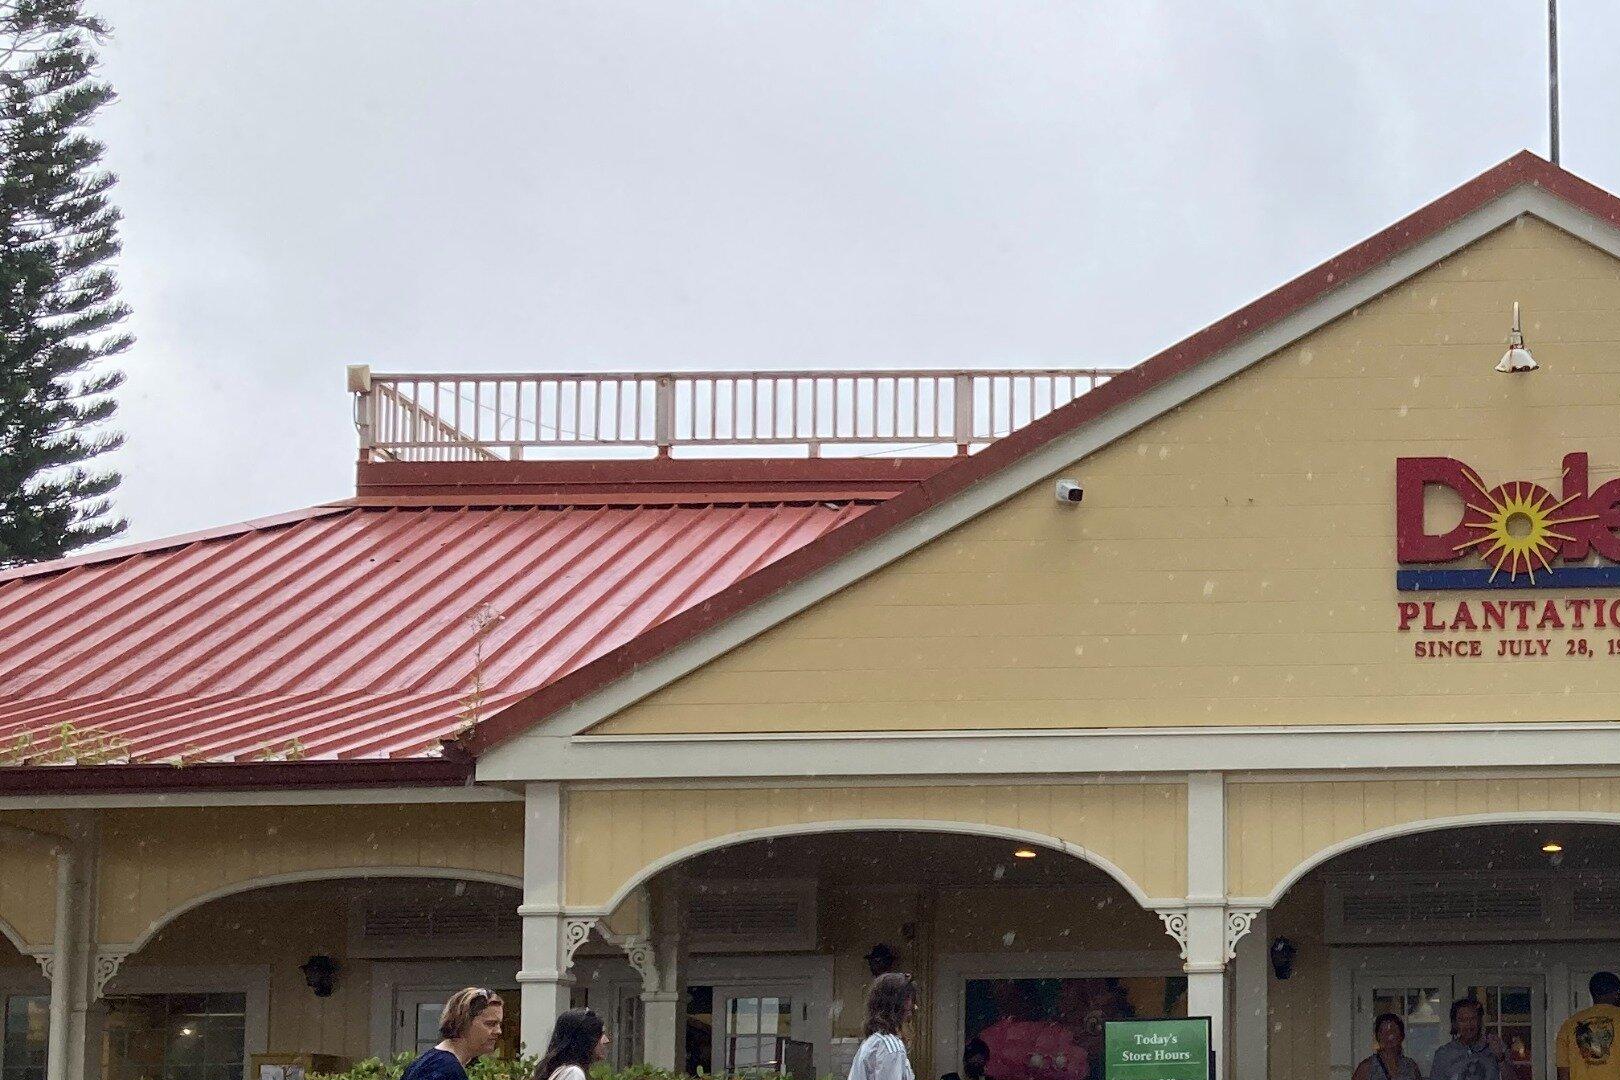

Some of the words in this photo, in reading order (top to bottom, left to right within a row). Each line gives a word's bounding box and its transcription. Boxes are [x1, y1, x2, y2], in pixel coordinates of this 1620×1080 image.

[1414, 640, 1483, 658] SINCE
[1497, 639, 1551, 657] JULY
[1566, 639, 1594, 658] 28,
[1134, 1033, 1178, 1046] Today's
[1122, 1050, 1152, 1061] Store
[1154, 1050, 1191, 1061] Hours
